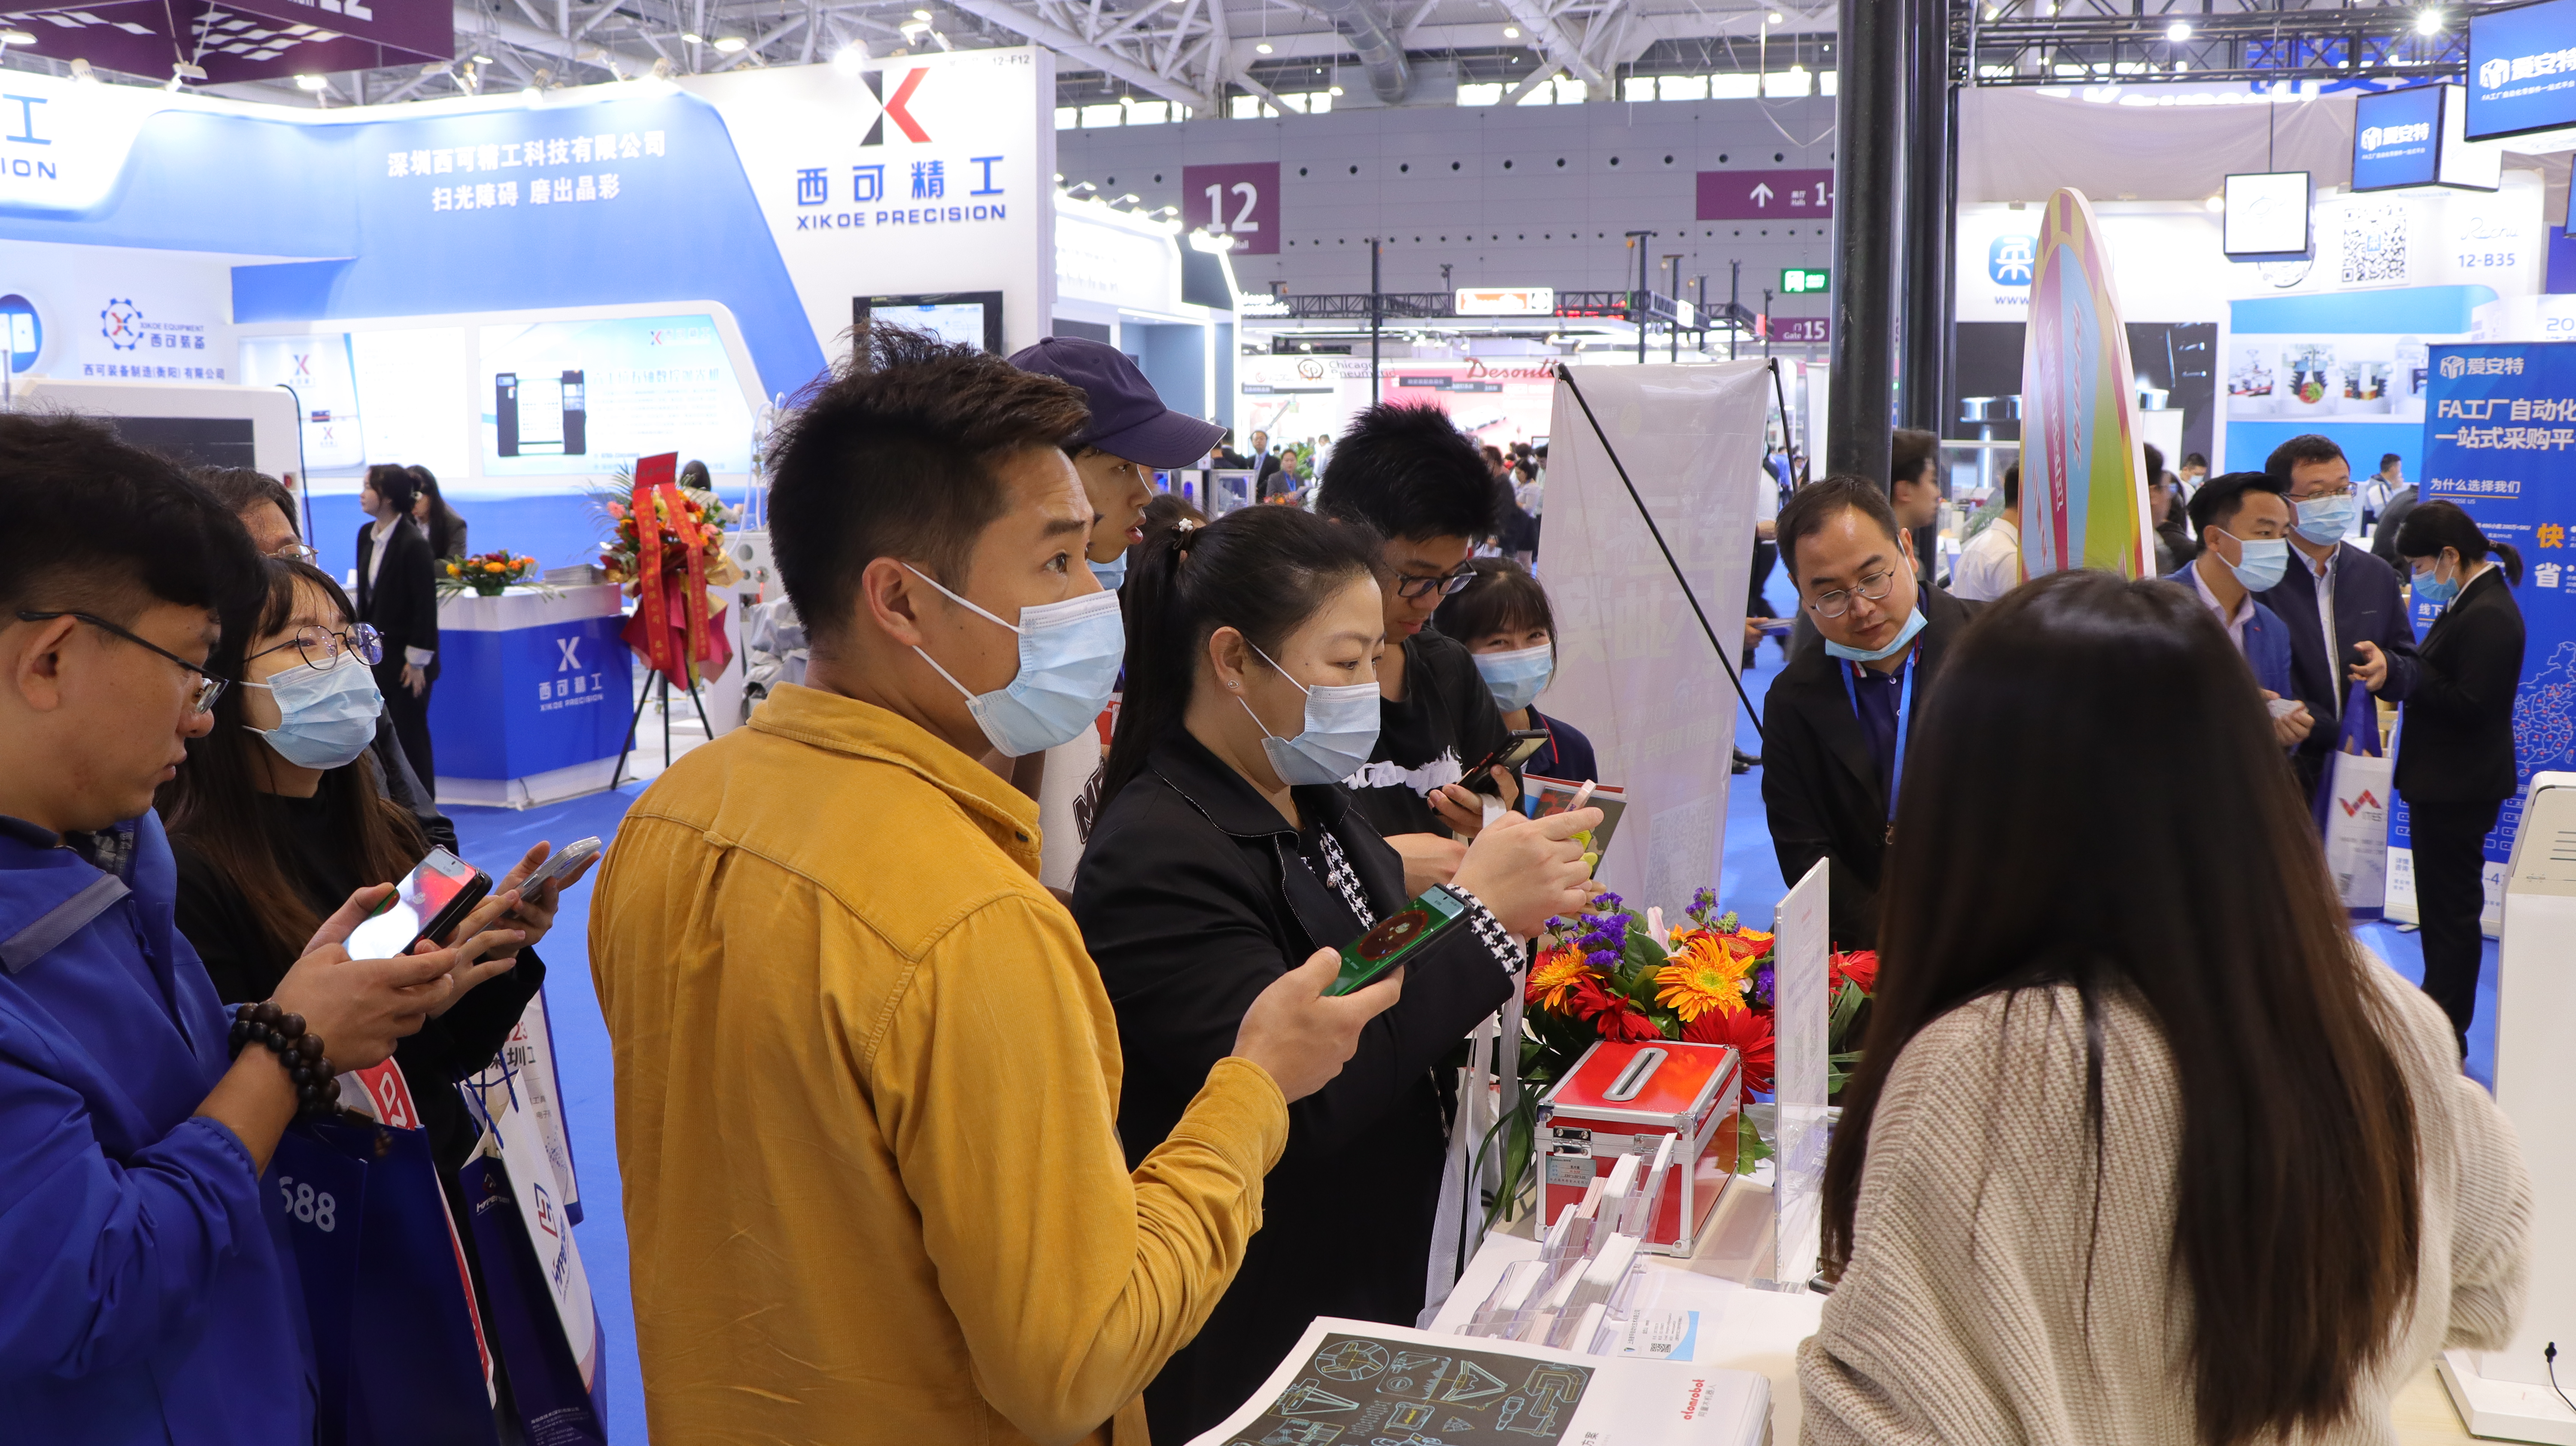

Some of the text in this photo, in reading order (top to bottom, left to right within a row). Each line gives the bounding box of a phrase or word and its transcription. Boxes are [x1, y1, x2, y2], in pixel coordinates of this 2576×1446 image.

[993, 55, 1030, 66] 12-F12
[388, 129, 665, 177] 深圳西可精工科技有限公司
[797, 155, 1004, 206] 西可精工
[797, 204, 1005, 231] XIKOE PRECISION
[1205, 182, 1258, 232] 12
[1235, 240, 1249, 249] Hall
[2458, 253, 2515, 267] 12-B35
[1783, 321, 1825, 340] Gate 15
[2467, 357, 2524, 375] 爱安特
[2438, 398, 2576, 422] FA工厂自动化
[2430, 477, 2521, 493] 为什么选择我们
[2537, 523, 2565, 549] 快
[2535, 562, 2562, 588] 省
[565, 693, 603, 706] PRECISION
[1680, 1379, 1705, 1420] atomrobot
